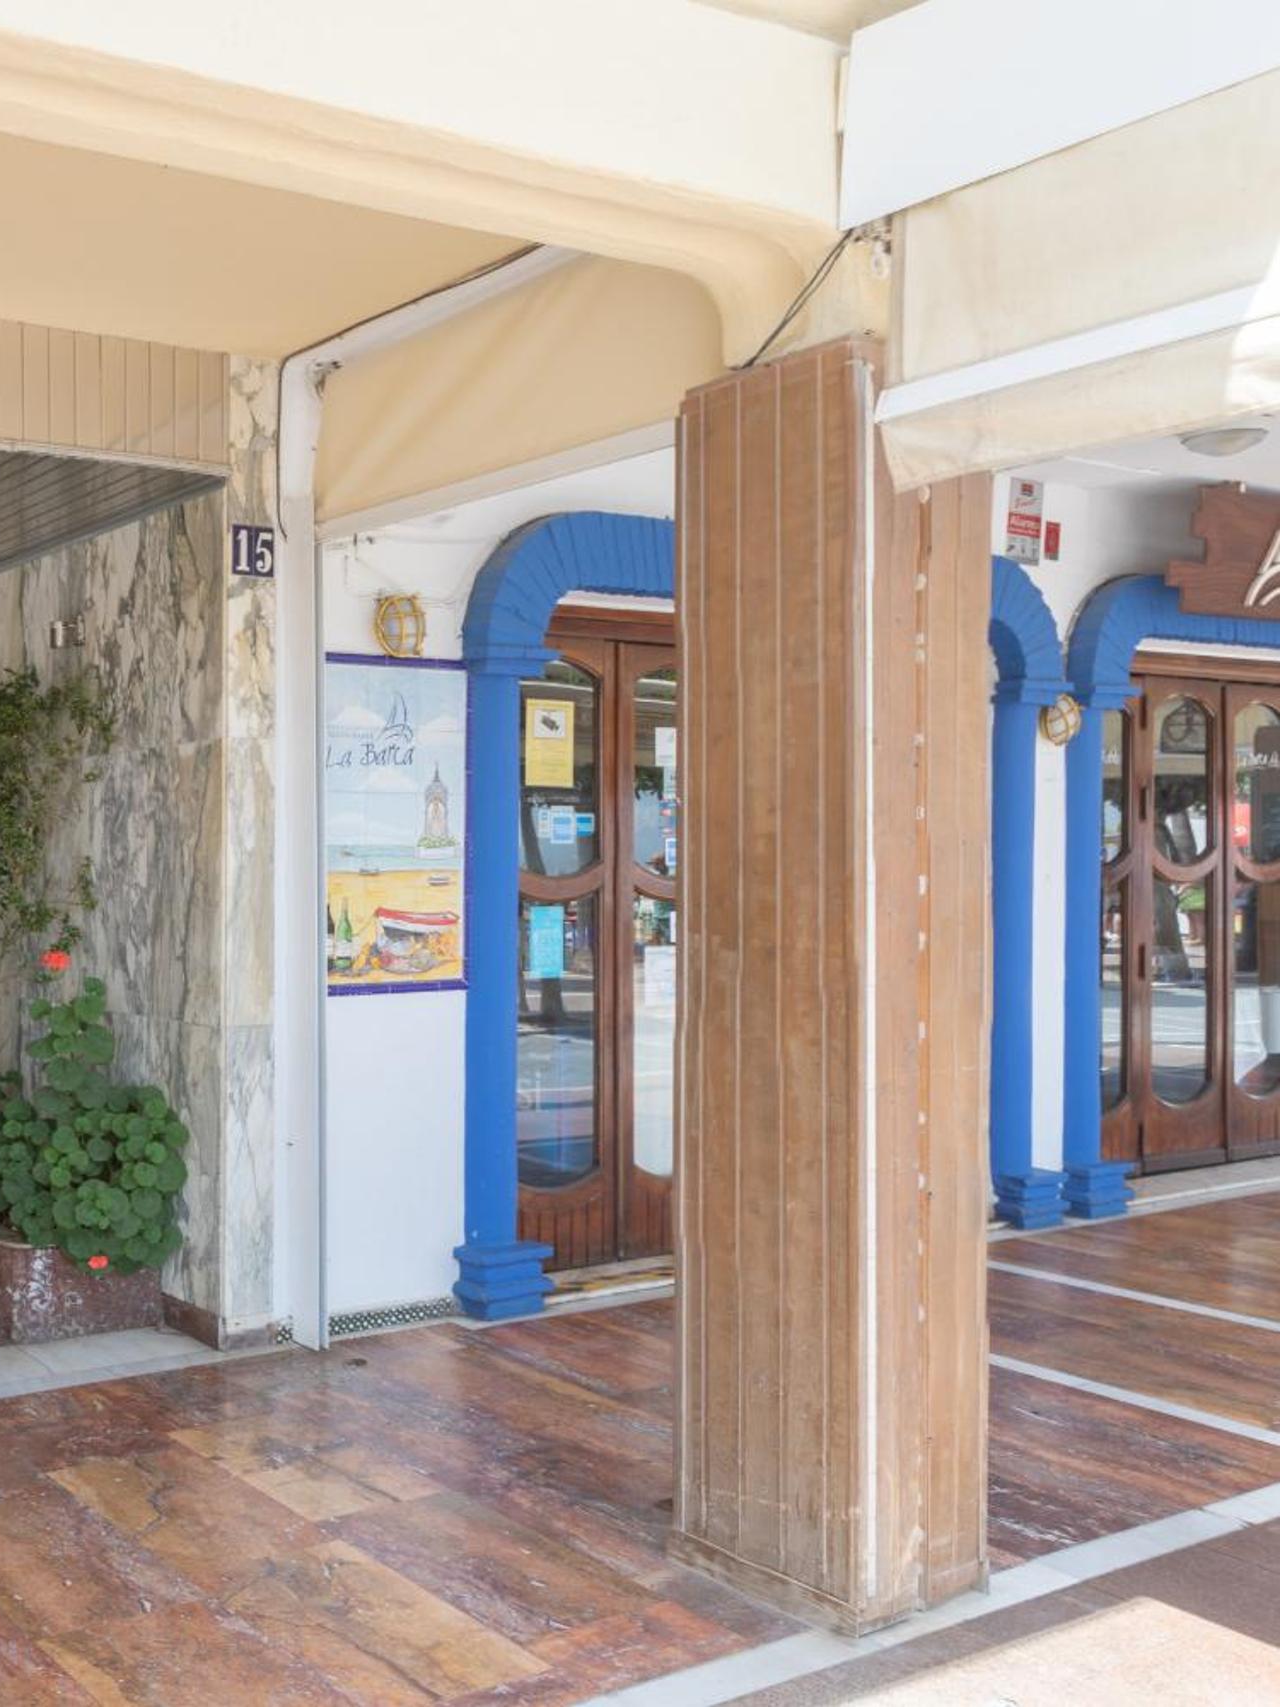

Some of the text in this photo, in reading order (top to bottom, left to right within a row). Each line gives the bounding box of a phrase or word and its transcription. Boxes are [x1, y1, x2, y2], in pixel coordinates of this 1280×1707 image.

[236, 529, 272, 573] 15
[325, 743, 416, 770] La Barca
